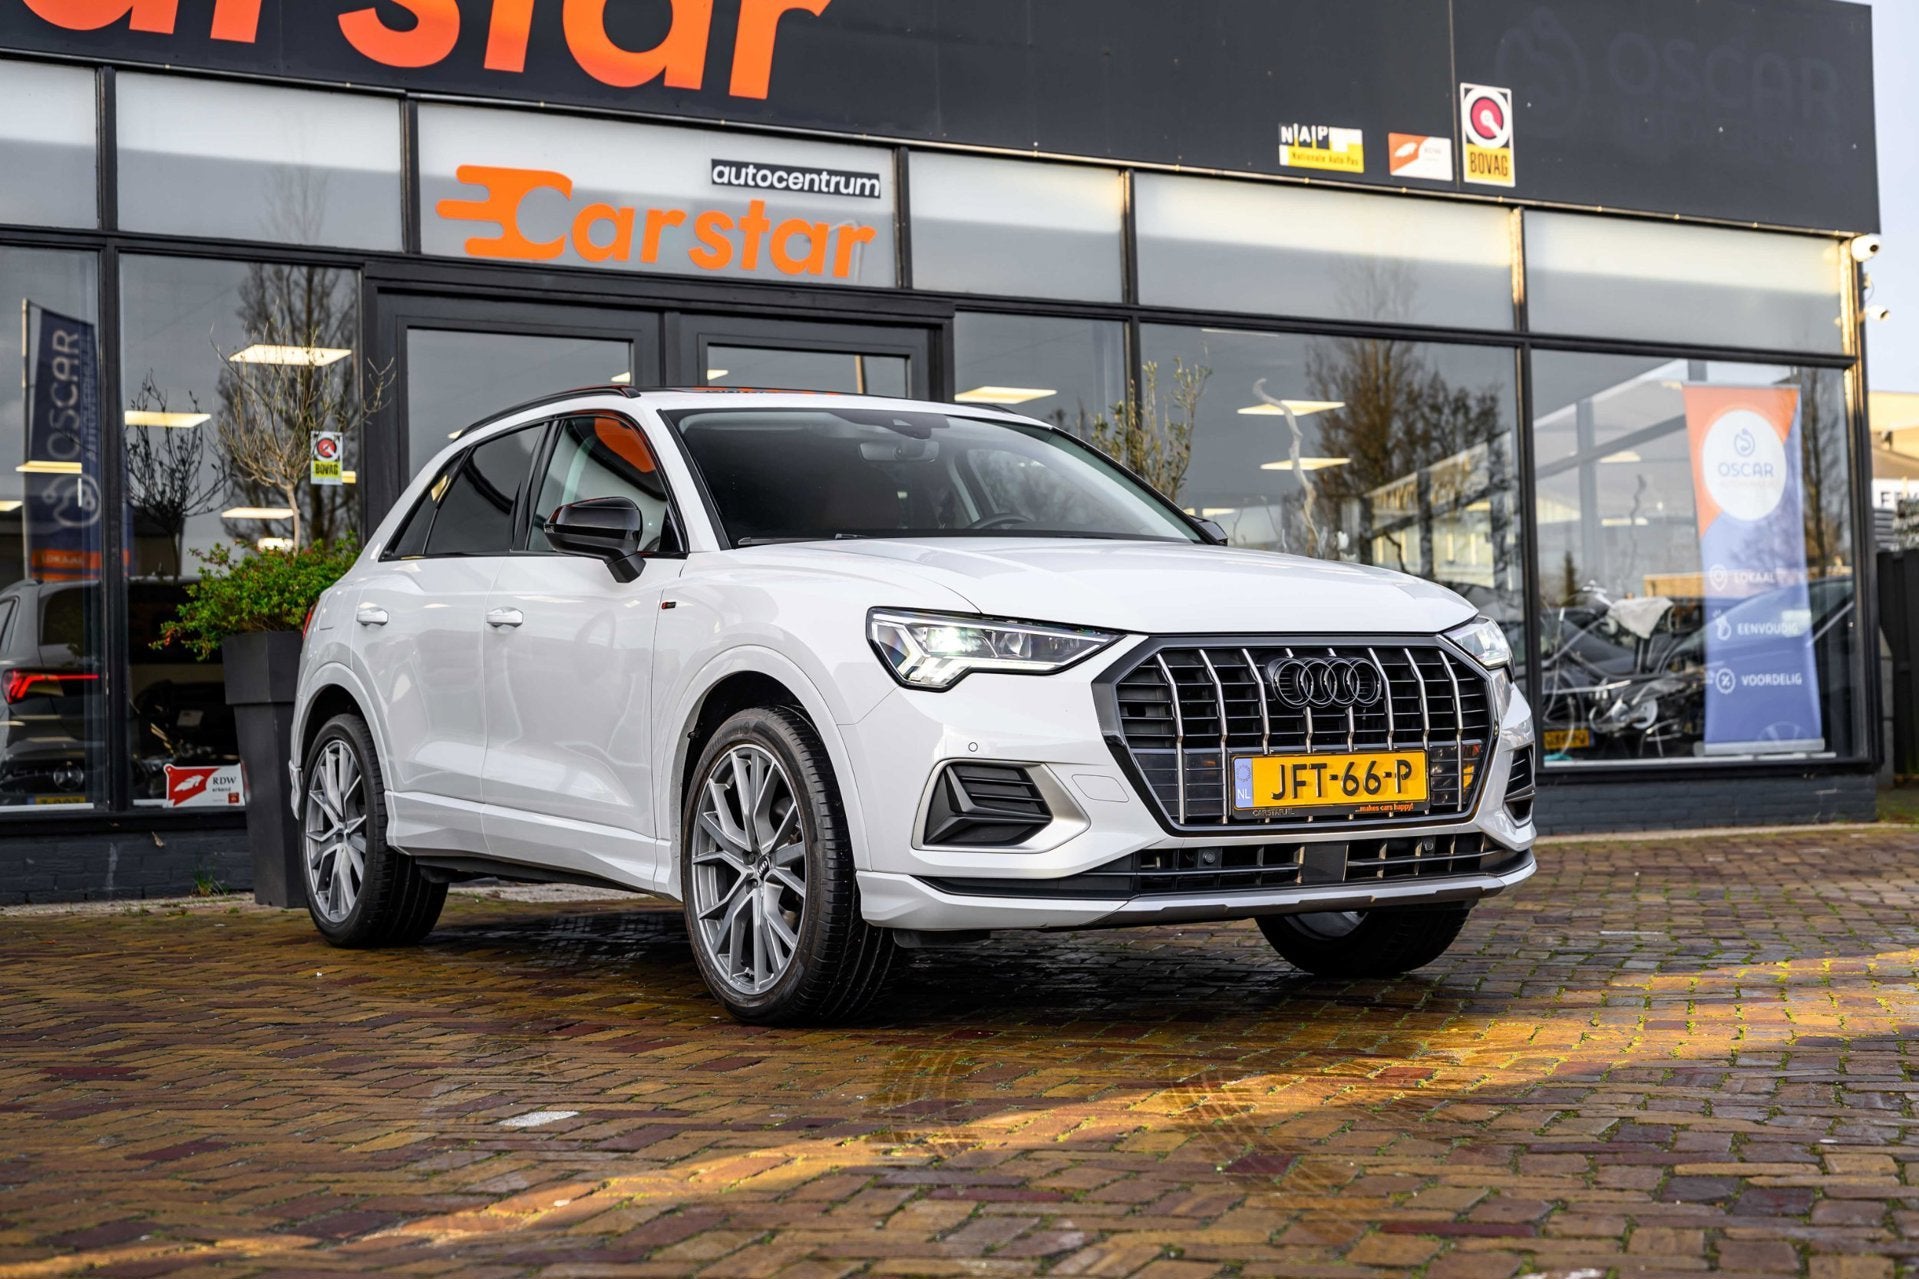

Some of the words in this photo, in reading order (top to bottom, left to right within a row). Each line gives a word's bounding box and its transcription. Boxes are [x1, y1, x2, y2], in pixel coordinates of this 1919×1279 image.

[1469, 152, 1509, 177] BOVAG
[712, 164, 880, 197] autocentrum
[435, 164, 877, 279] Carstar
[47, 330, 79, 459] OSCAR
[315, 463, 338, 475] BOVAG
[1718, 462, 1775, 478] OSCAR
[1733, 572, 1775, 584] LOKAAL
[1737, 623, 1799, 635] EENVOUDIG
[1741, 672, 1802, 686] VOORDELIG
[212, 776, 237, 785] RDW
[1271, 759, 1412, 801] JFT-66-P
[1237, 788, 1250, 800] NL
